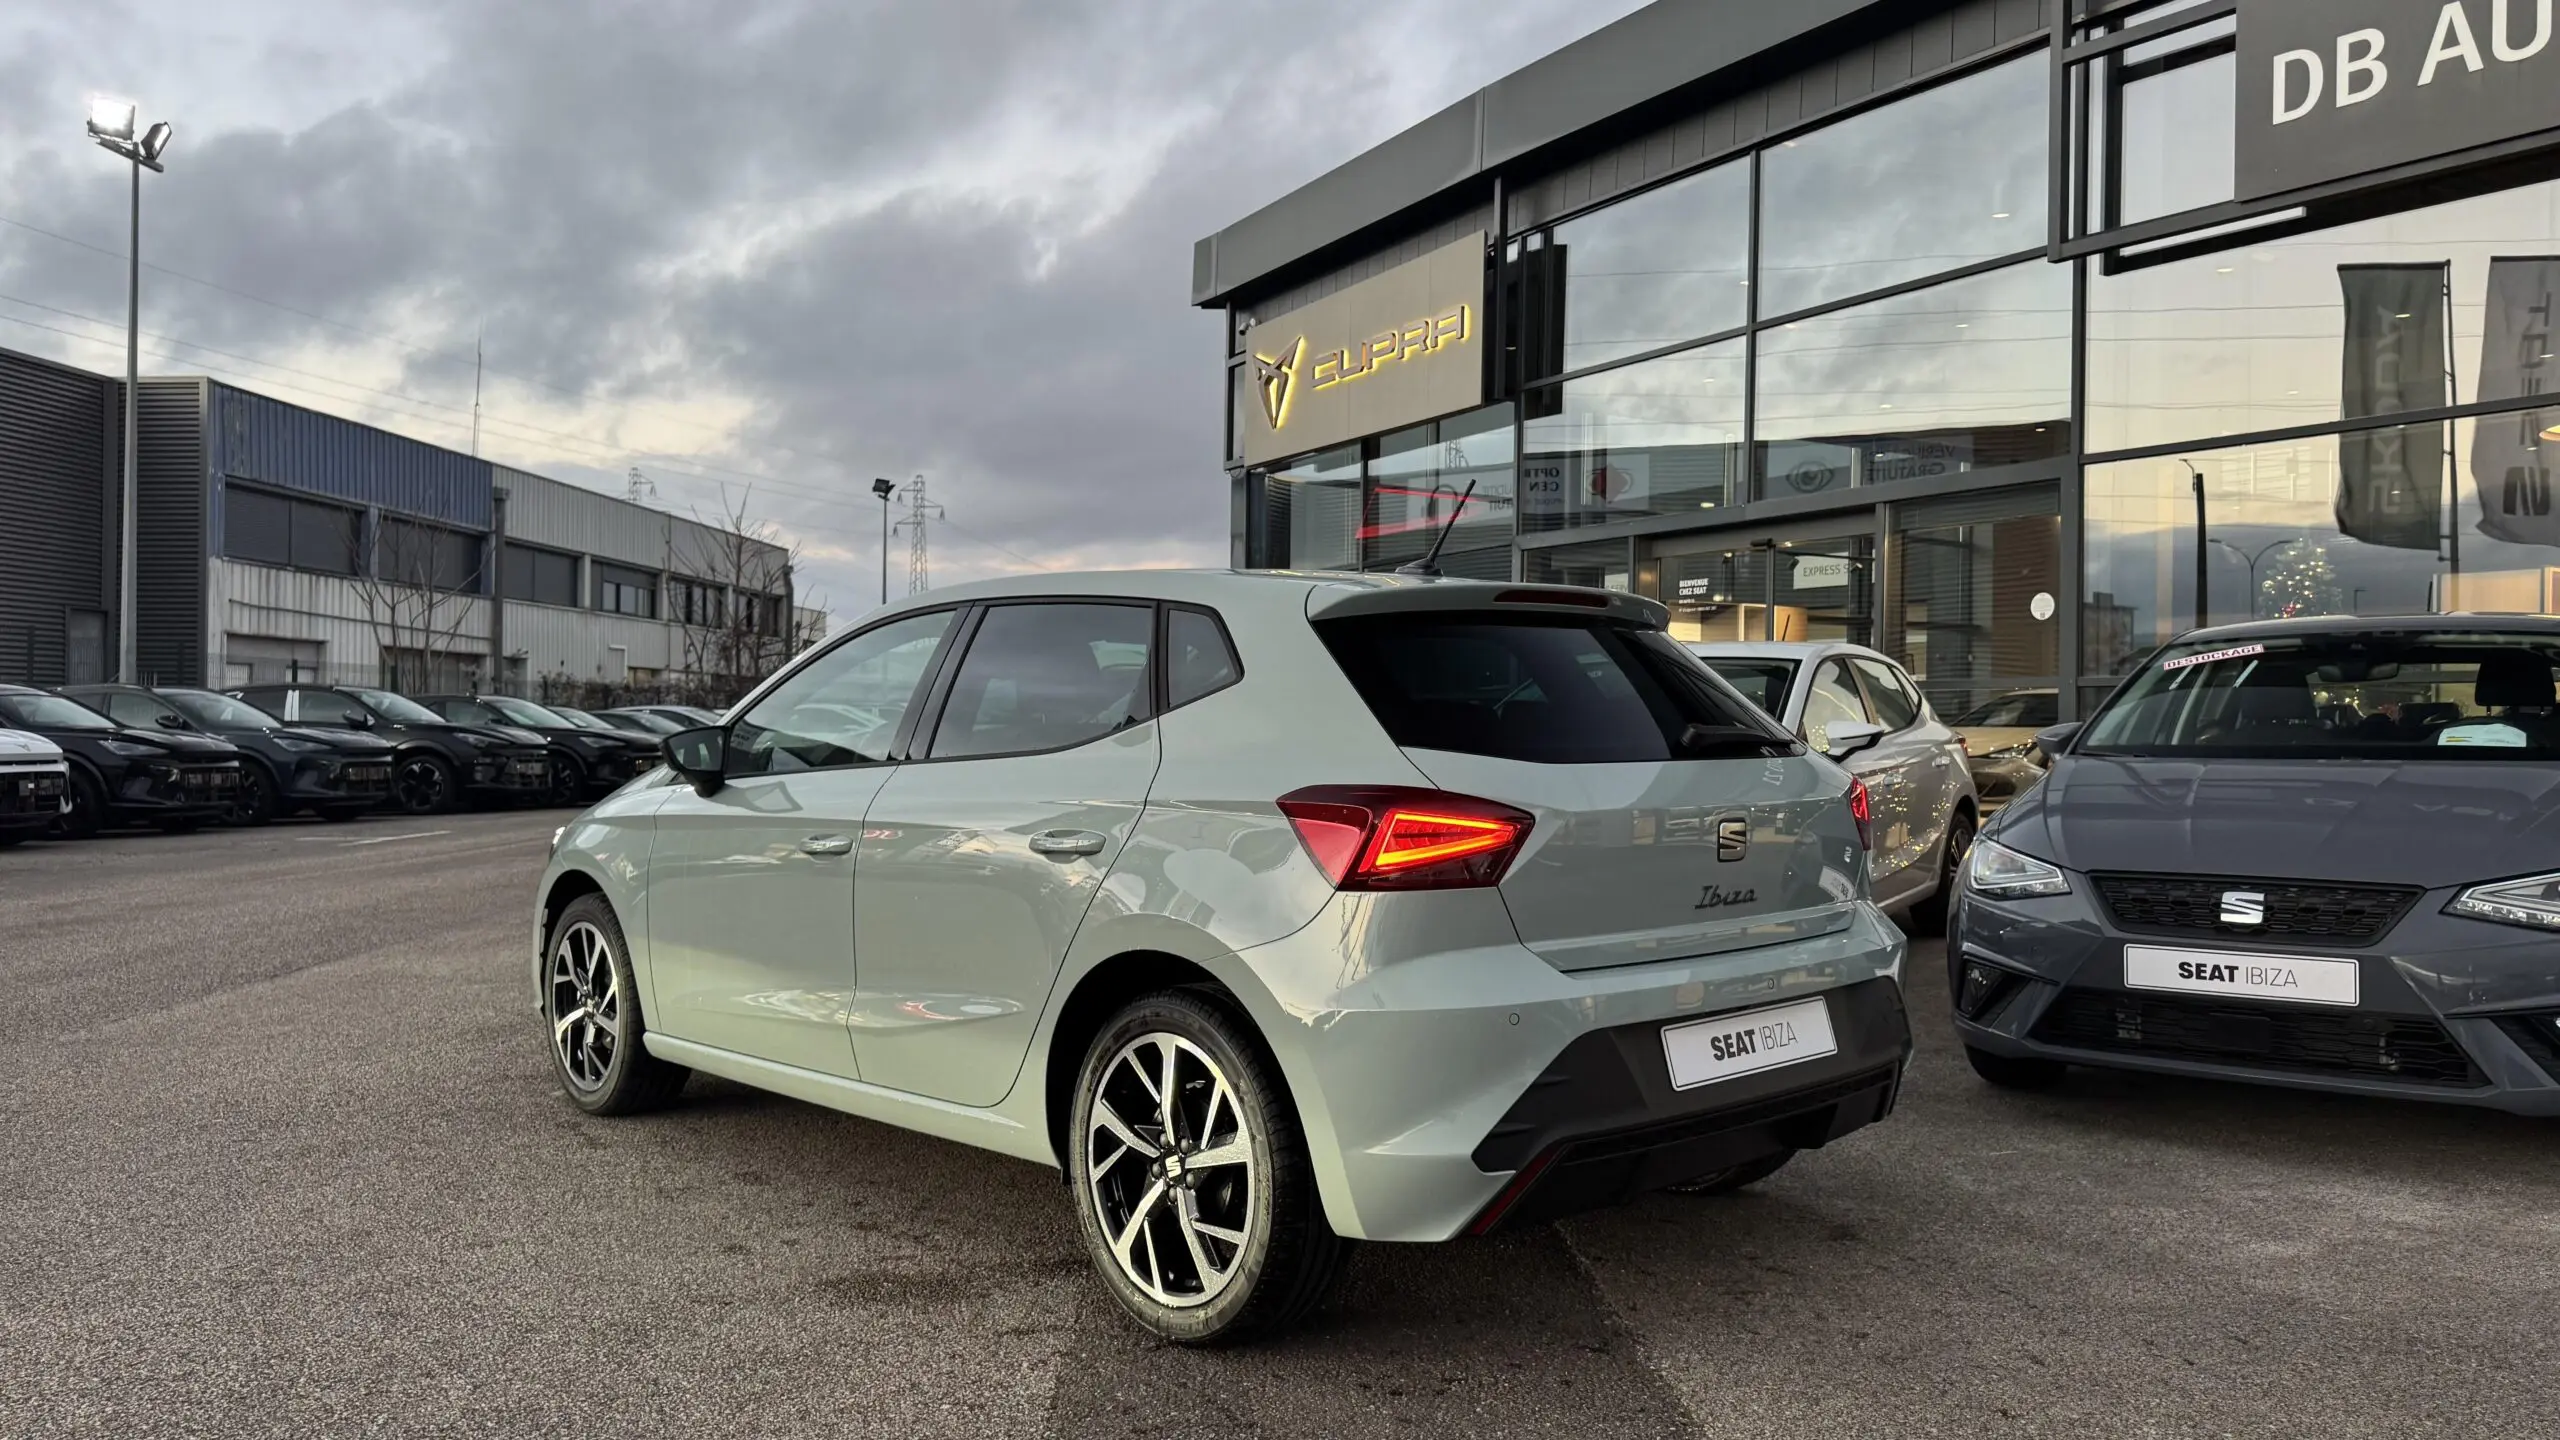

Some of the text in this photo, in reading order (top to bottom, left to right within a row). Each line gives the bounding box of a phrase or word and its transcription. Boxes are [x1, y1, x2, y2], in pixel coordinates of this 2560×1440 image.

[2272, 28, 2388, 126] DB
[1312, 305, 1467, 389] CUPRA
[1679, 578, 1709, 588] BIENVENUE
[1803, 564, 1841, 577] EXPRESS
[1679, 587, 1707, 596] CHEZ SEAT
[2166, 645, 2260, 669] DESTOCKAGE
[1695, 885, 1758, 910] Ibiza
[2178, 961, 2298, 988] SEAT IBIZA
[1710, 1021, 1798, 1061] SEAT IBIZA
